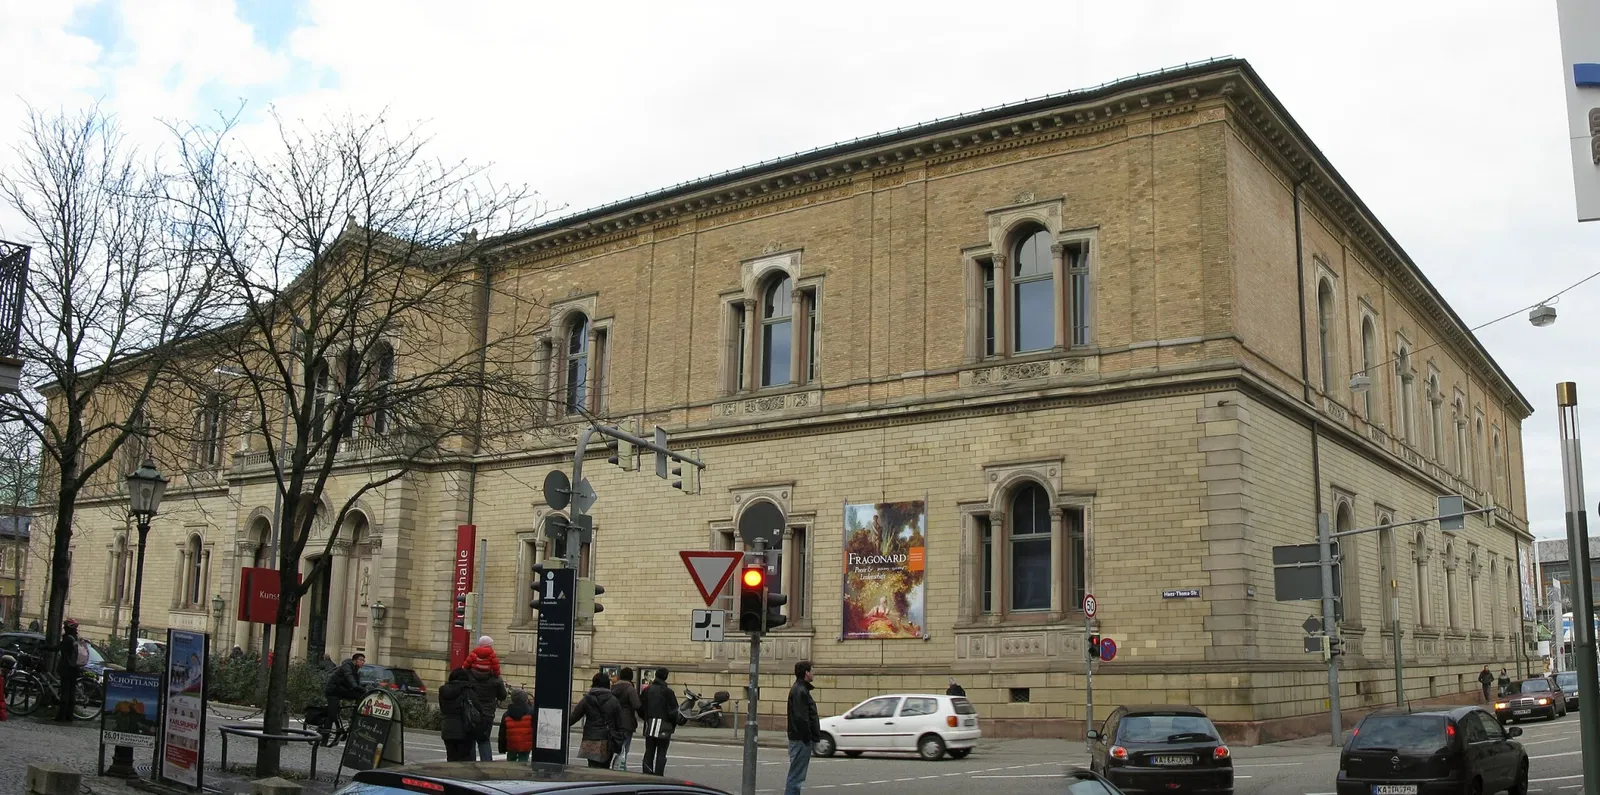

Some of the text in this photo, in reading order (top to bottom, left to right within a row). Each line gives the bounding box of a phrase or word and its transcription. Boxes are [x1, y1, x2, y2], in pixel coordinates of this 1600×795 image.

[849, 552, 907, 565] FRAGONARD
[455, 549, 469, 628] nsthalle
[1087, 600, 1094, 612] 50
[108, 673, 160, 688] SCHOTTLAND
[374, 707, 390, 717] PILS
